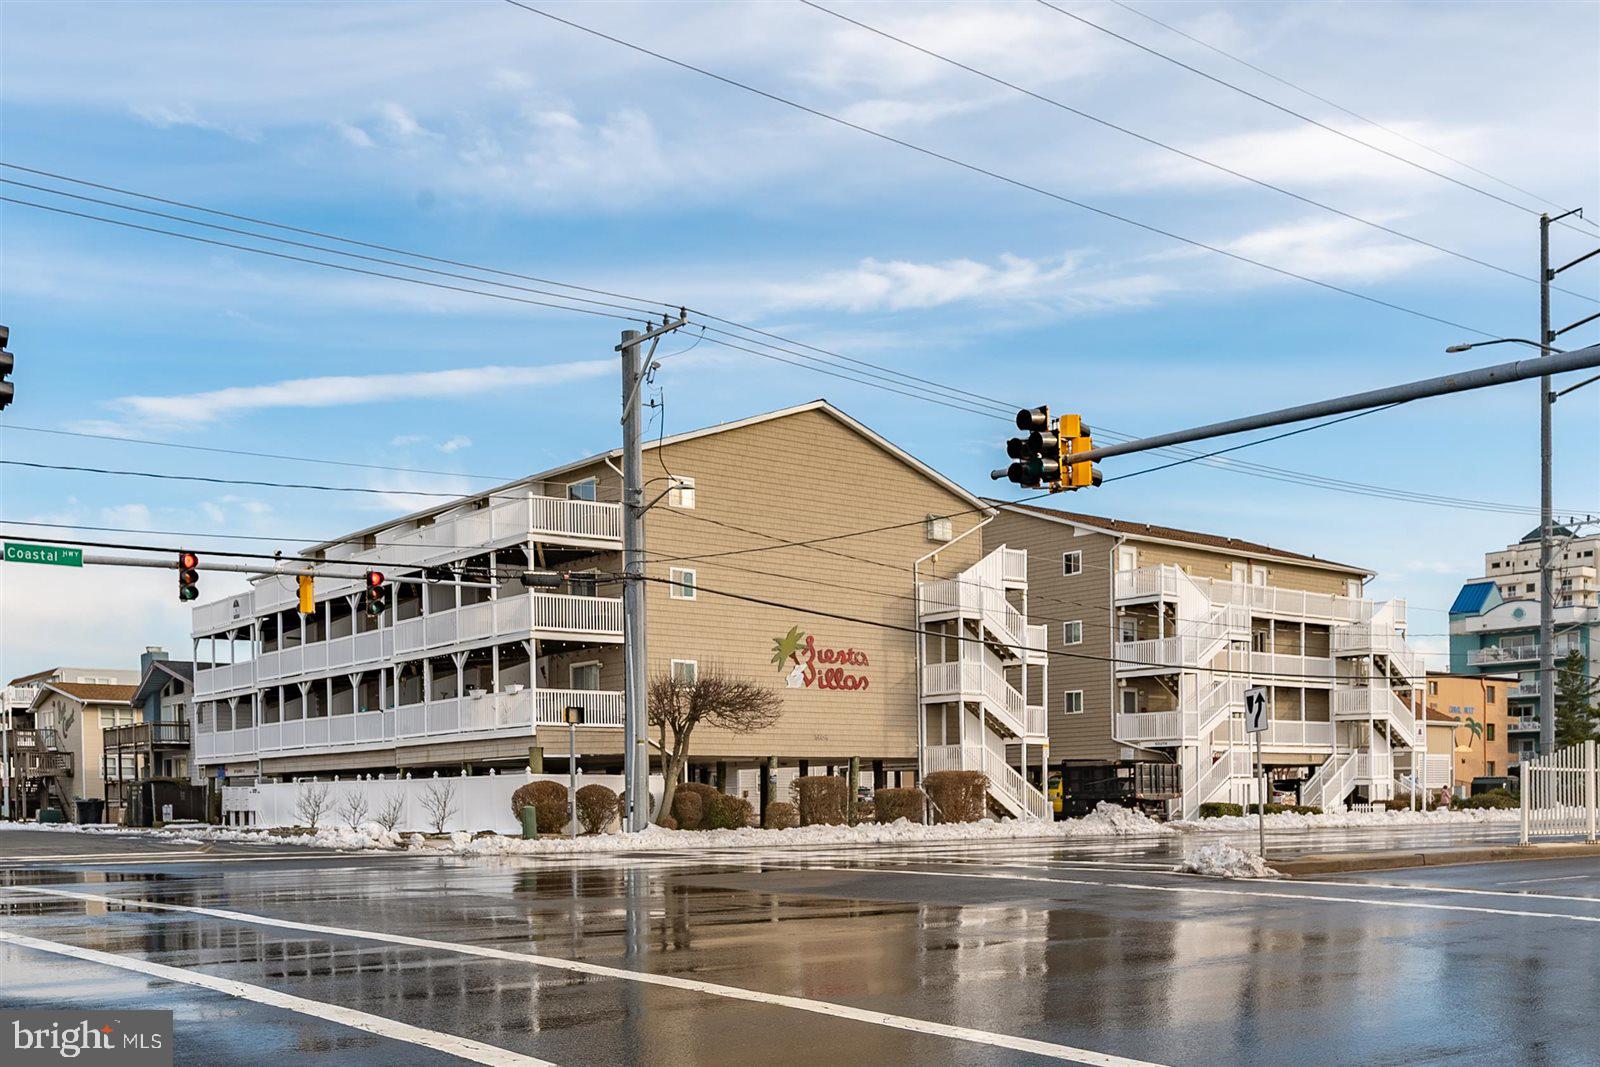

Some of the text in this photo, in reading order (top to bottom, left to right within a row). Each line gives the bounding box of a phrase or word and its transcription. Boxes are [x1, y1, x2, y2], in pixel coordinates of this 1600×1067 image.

[7, 547, 58, 561] Coastal
[802, 635, 869, 666] Siesta
[803, 661, 869, 690] Villas
